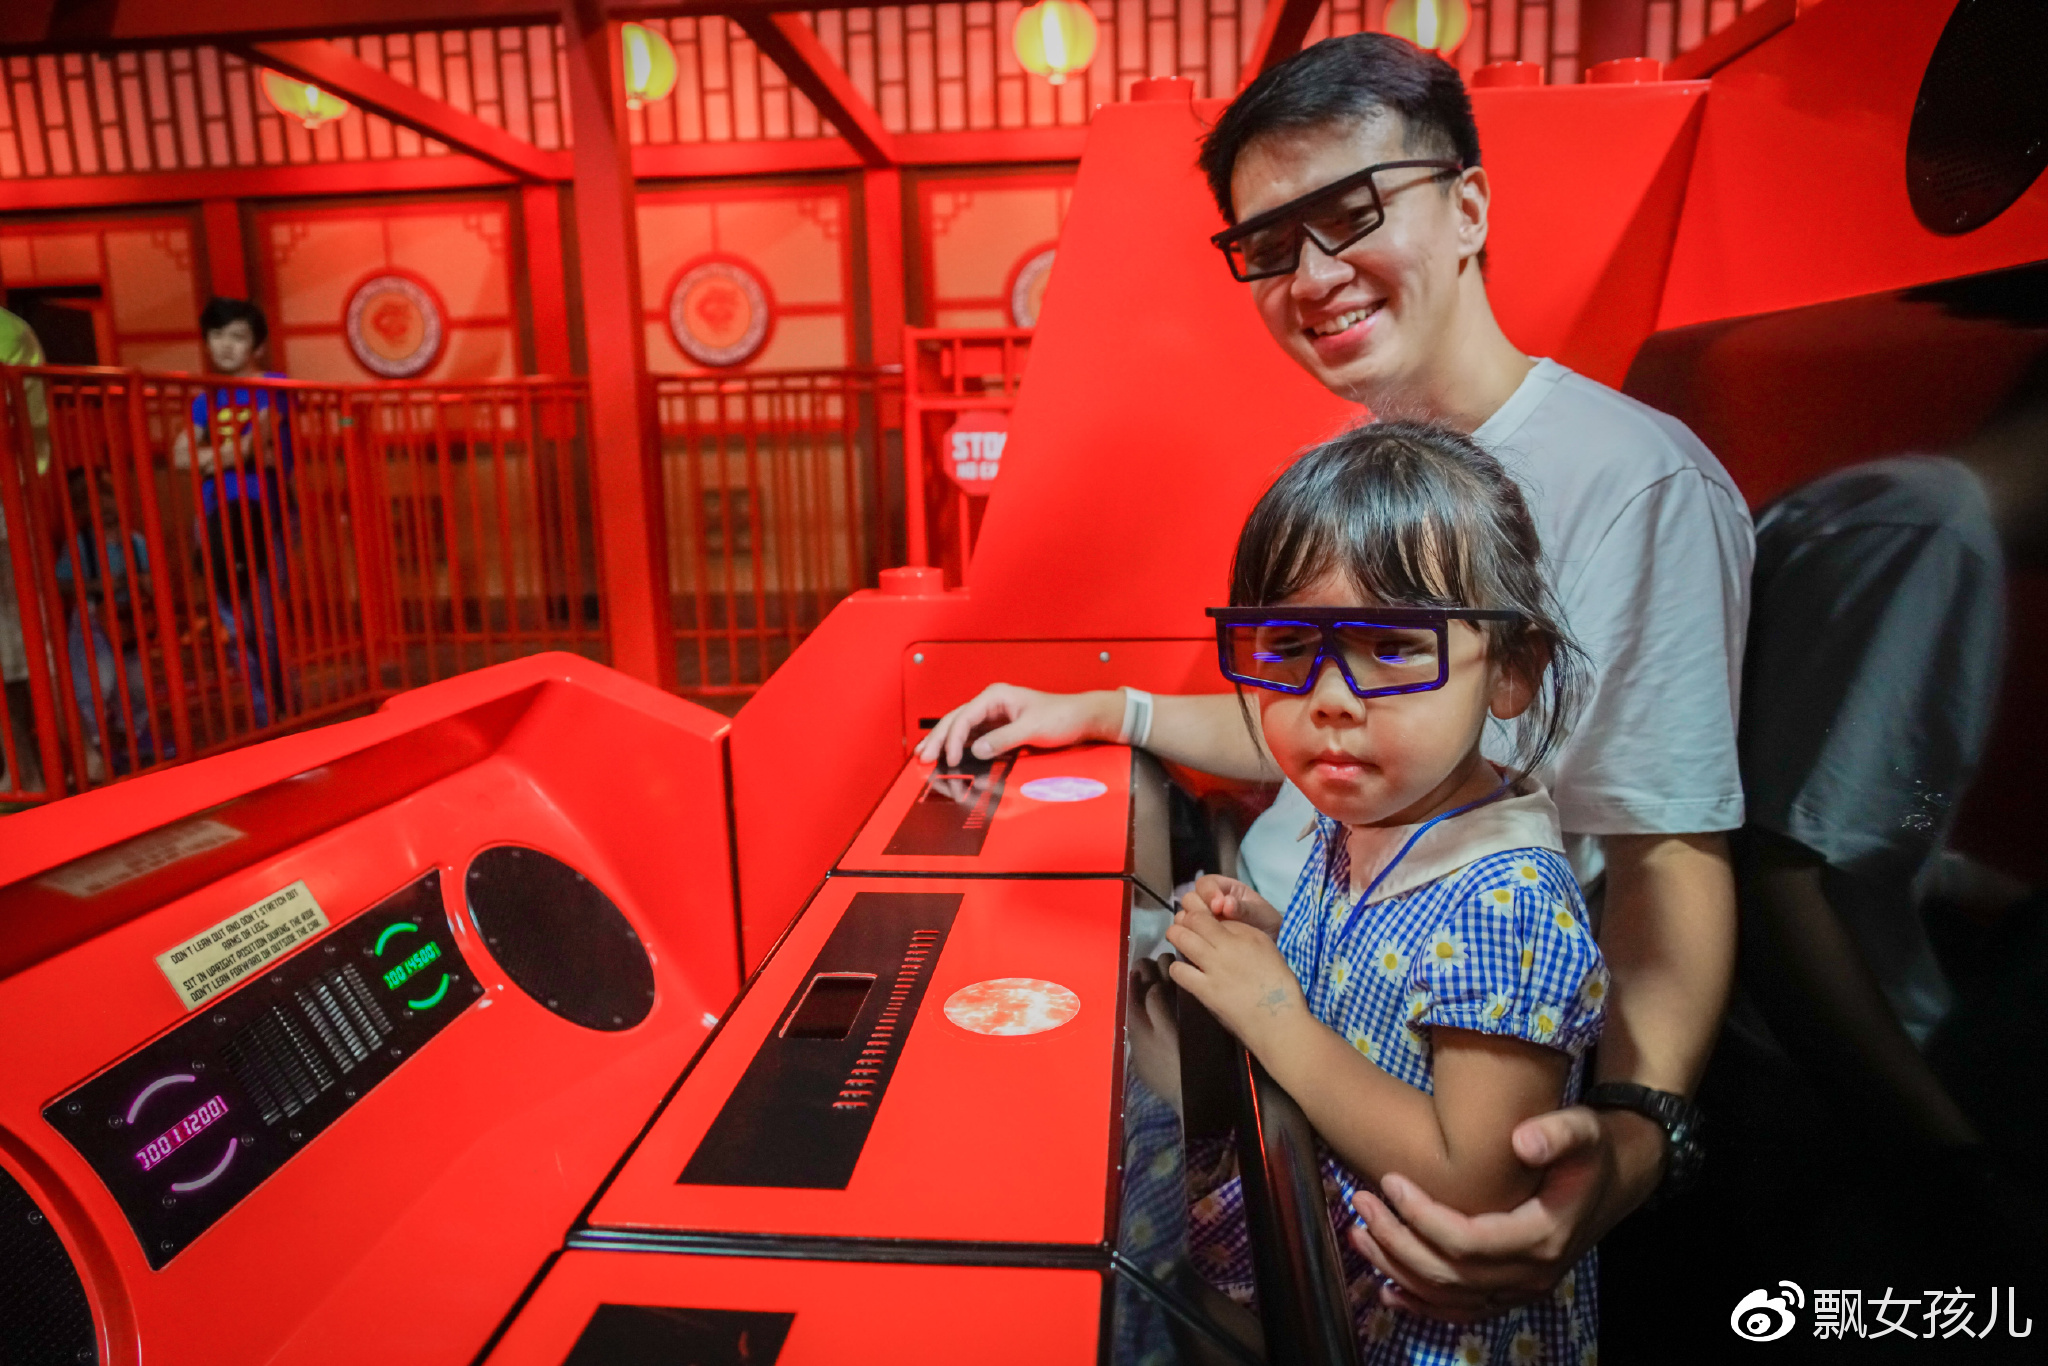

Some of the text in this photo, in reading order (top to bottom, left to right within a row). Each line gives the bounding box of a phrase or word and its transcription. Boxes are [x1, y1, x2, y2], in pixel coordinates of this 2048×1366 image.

[170, 888, 299, 965] DON'T LEAN OUT AND DON'T STRETCH OUT
[182, 908, 316, 991] SIT IN UPRIGHT POSITION DURING THE RIDE
[190, 983, 212, 1003] DON'T
[211, 972, 231, 990] LEAN
[229, 953, 262, 979] FORWARD
[260, 948, 272, 959] OR
[270, 933, 297, 954] OUTSIDE
[295, 926, 309, 938] THE
[221, 934, 242, 951] ARMS
[240, 928, 252, 940] OR
